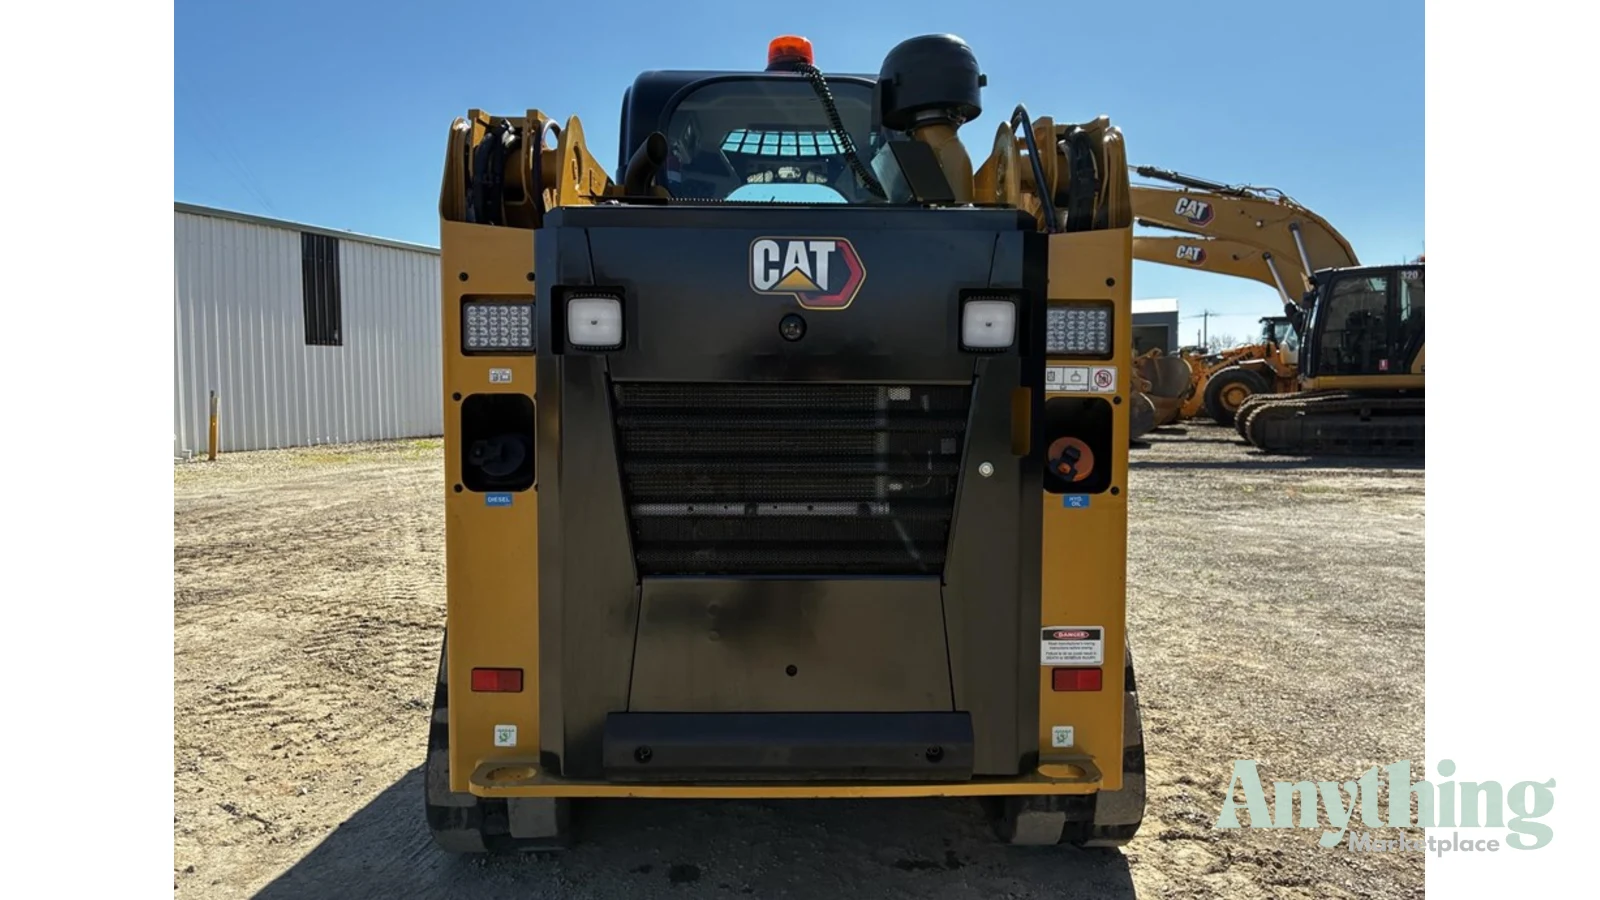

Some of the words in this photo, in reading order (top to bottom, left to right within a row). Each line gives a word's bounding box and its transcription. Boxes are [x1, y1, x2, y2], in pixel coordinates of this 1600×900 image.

[1175, 197, 1208, 220] CAT
[1176, 245, 1202, 261] CAT
[753, 239, 836, 292] CAT
